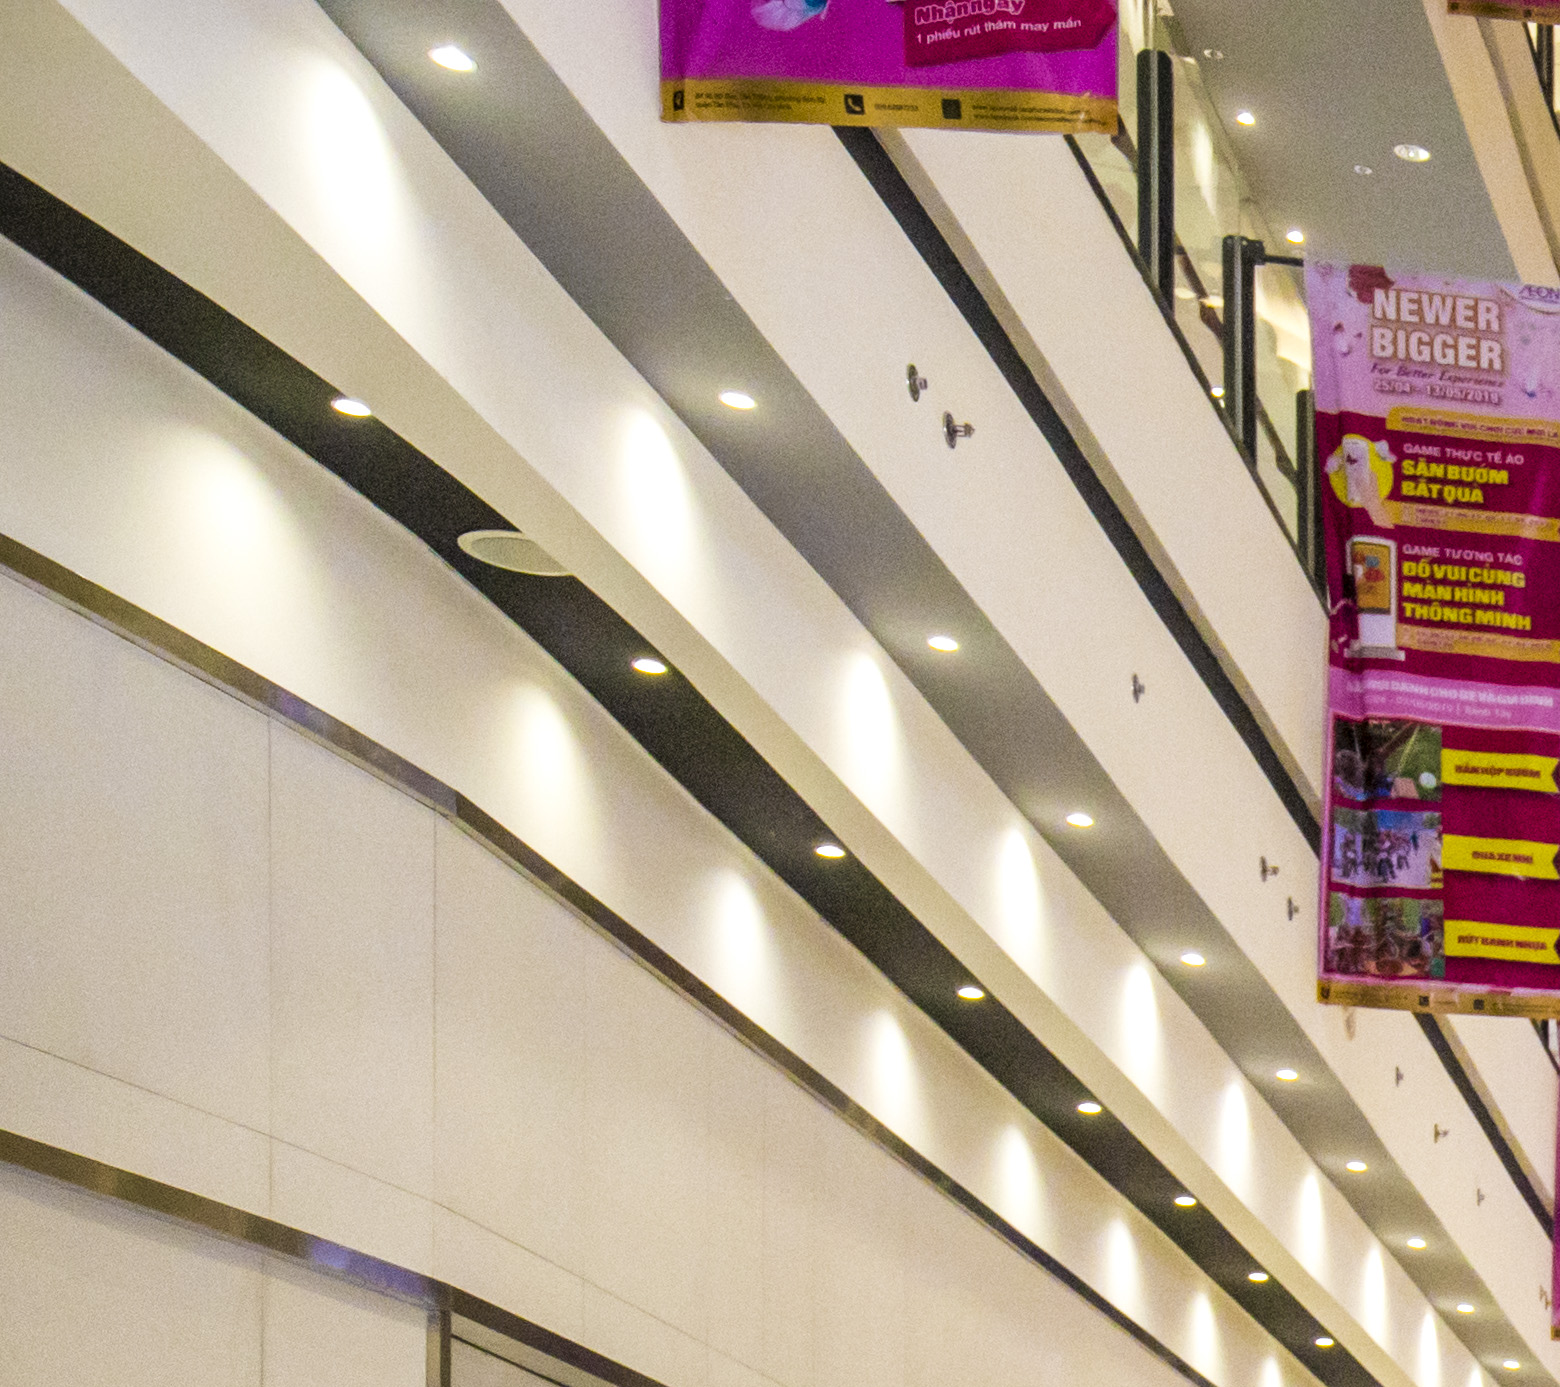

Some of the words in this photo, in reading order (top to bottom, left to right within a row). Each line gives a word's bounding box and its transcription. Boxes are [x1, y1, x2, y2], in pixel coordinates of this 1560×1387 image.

[1021, 21, 1050, 33] may
[1372, 287, 1502, 333] NEWER
[1371, 326, 1503, 372] BIGGER
[1403, 443, 1441, 458] GAME
[1402, 543, 1441, 557] GAME
[1475, 609, 1533, 632] MINH
